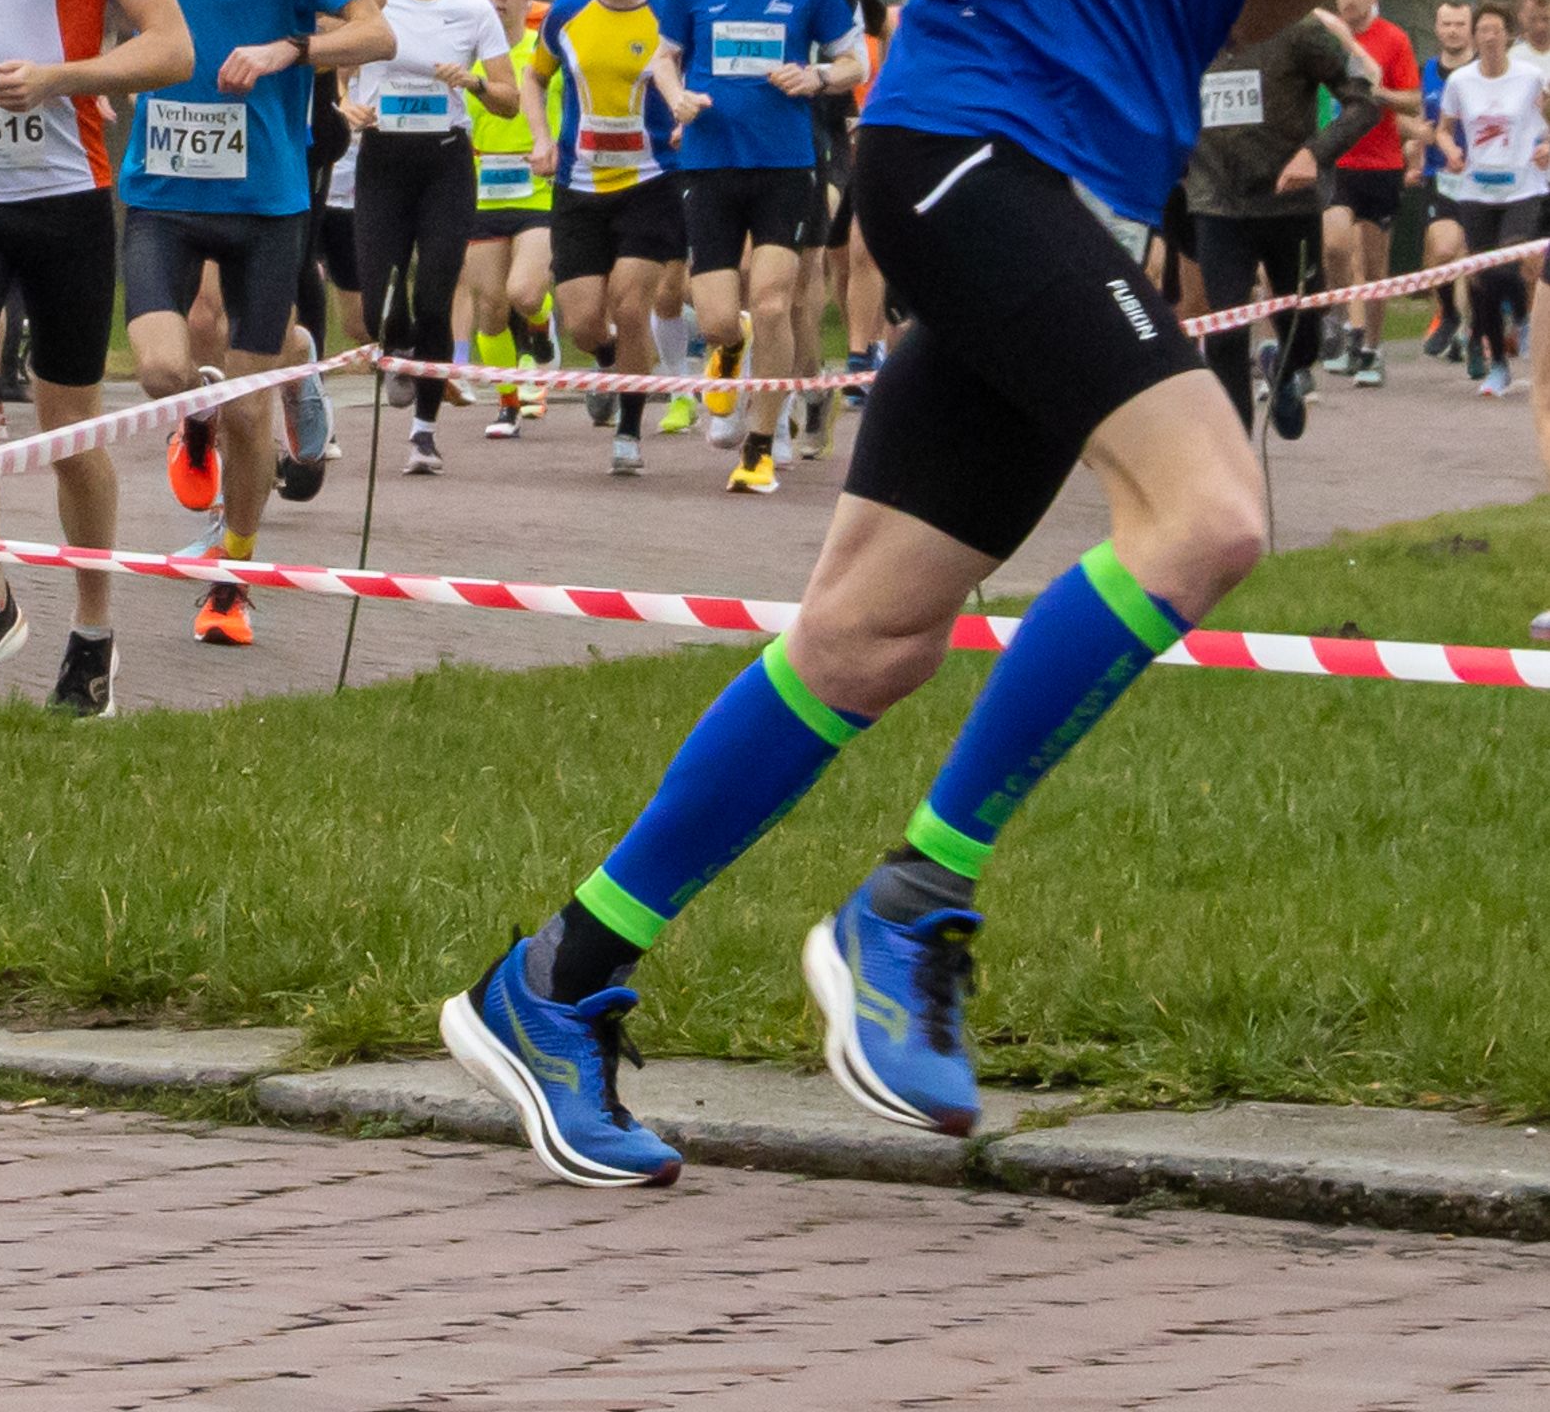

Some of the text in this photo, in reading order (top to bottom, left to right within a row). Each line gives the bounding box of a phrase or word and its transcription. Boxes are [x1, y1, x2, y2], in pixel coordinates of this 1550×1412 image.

[156, 104, 239, 126] Verhoog's
[399, 96, 431, 114] 724
[150, 125, 244, 155] M7674
[1105, 279, 1159, 340] FUSION
